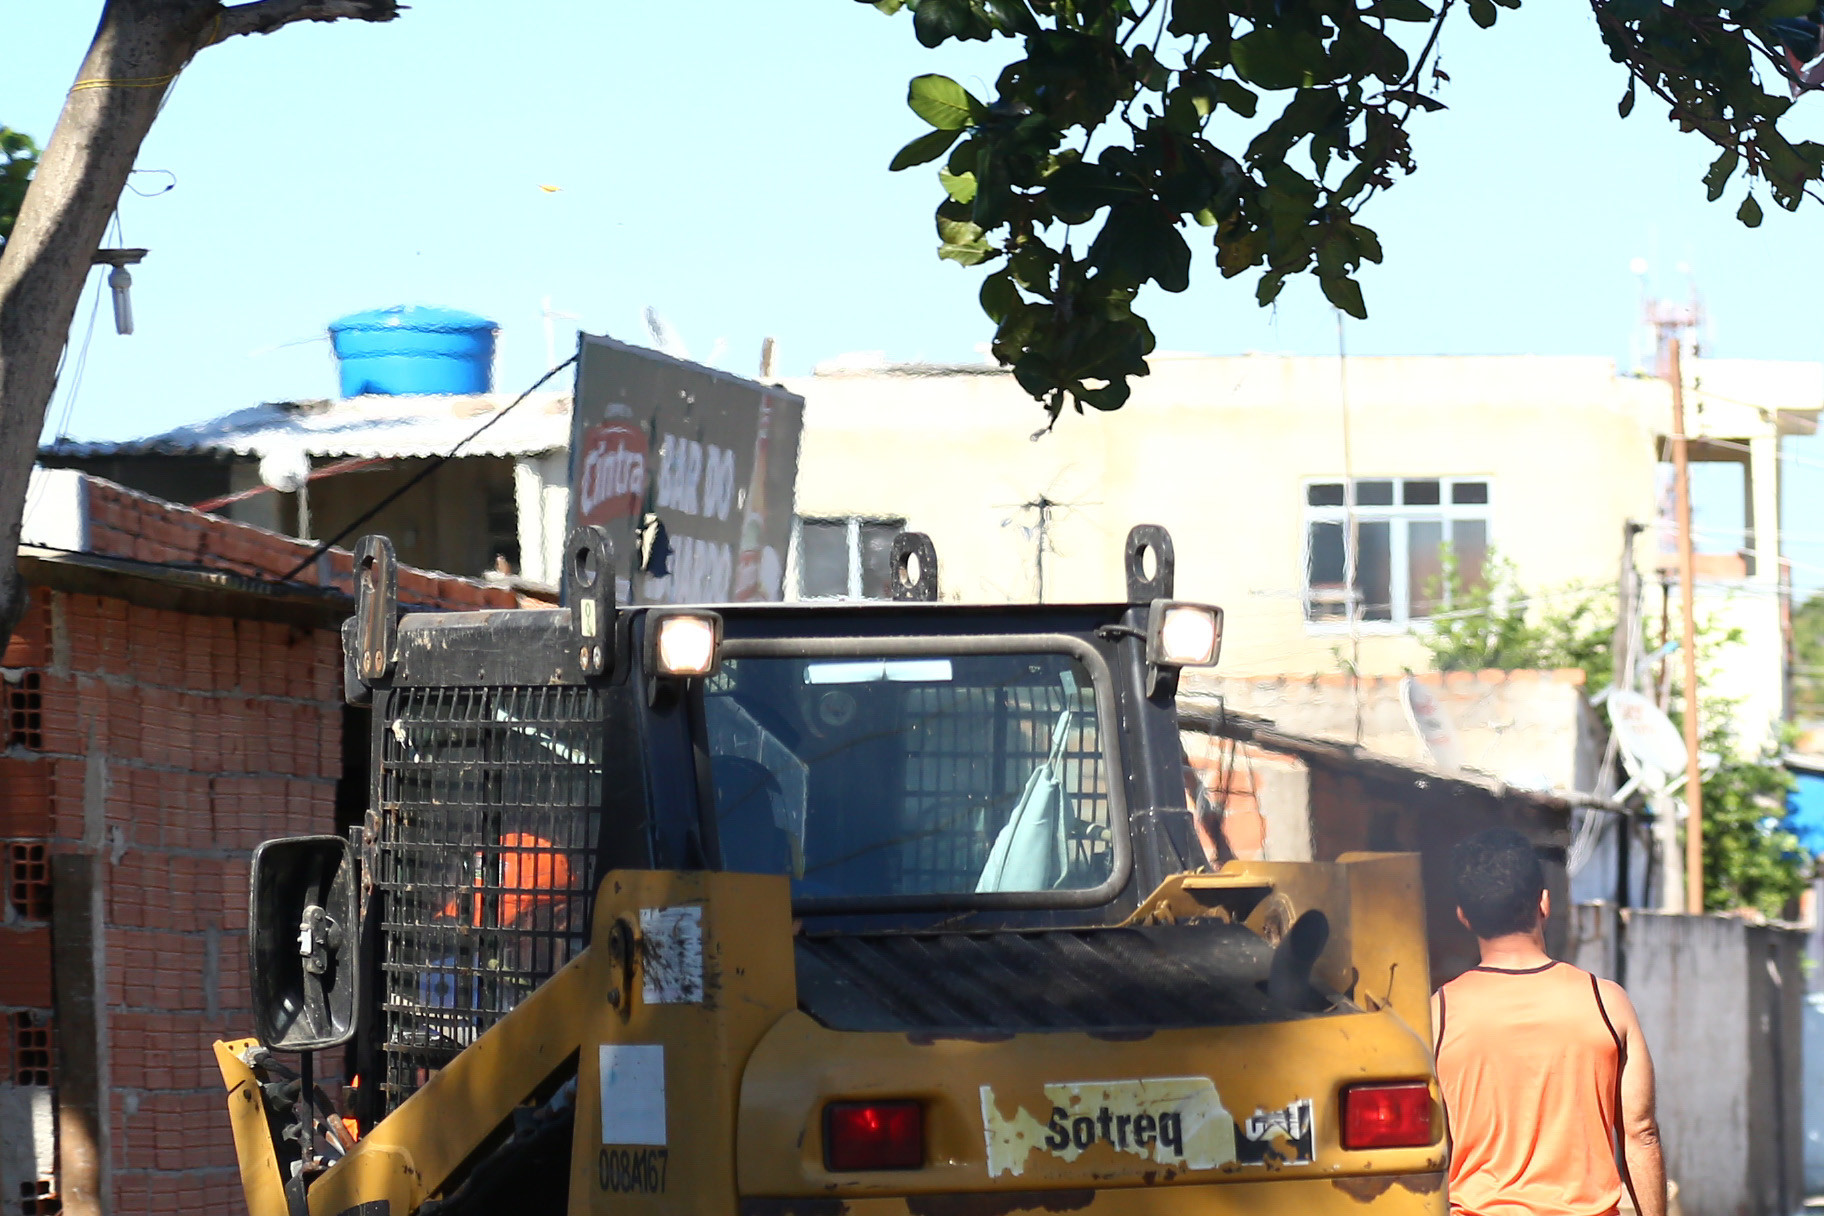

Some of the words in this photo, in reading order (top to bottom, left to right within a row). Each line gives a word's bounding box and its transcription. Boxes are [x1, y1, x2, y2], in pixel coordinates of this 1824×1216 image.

[581, 441, 645, 516] Cintra
[657, 433, 703, 514] BAR
[1045, 1104, 1185, 1157] Sotreq
